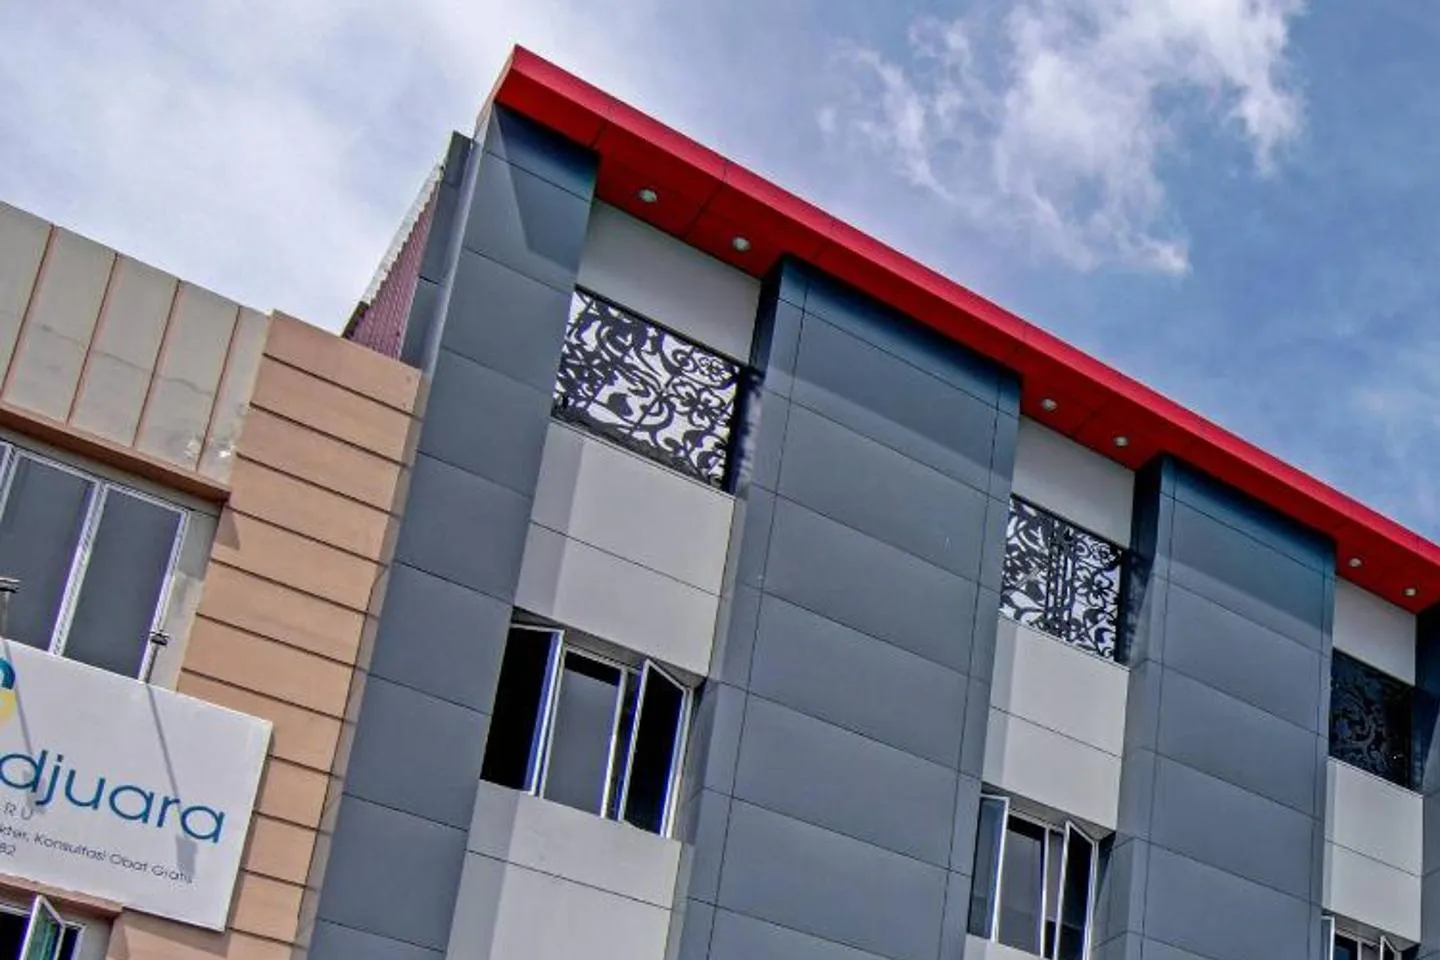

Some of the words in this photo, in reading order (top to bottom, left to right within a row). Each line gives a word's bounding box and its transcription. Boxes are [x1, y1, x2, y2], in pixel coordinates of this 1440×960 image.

[0, 750, 225, 843] djuara
[34, 833, 106, 861] Konsultasi
[109, 853, 148, 872] Obat
